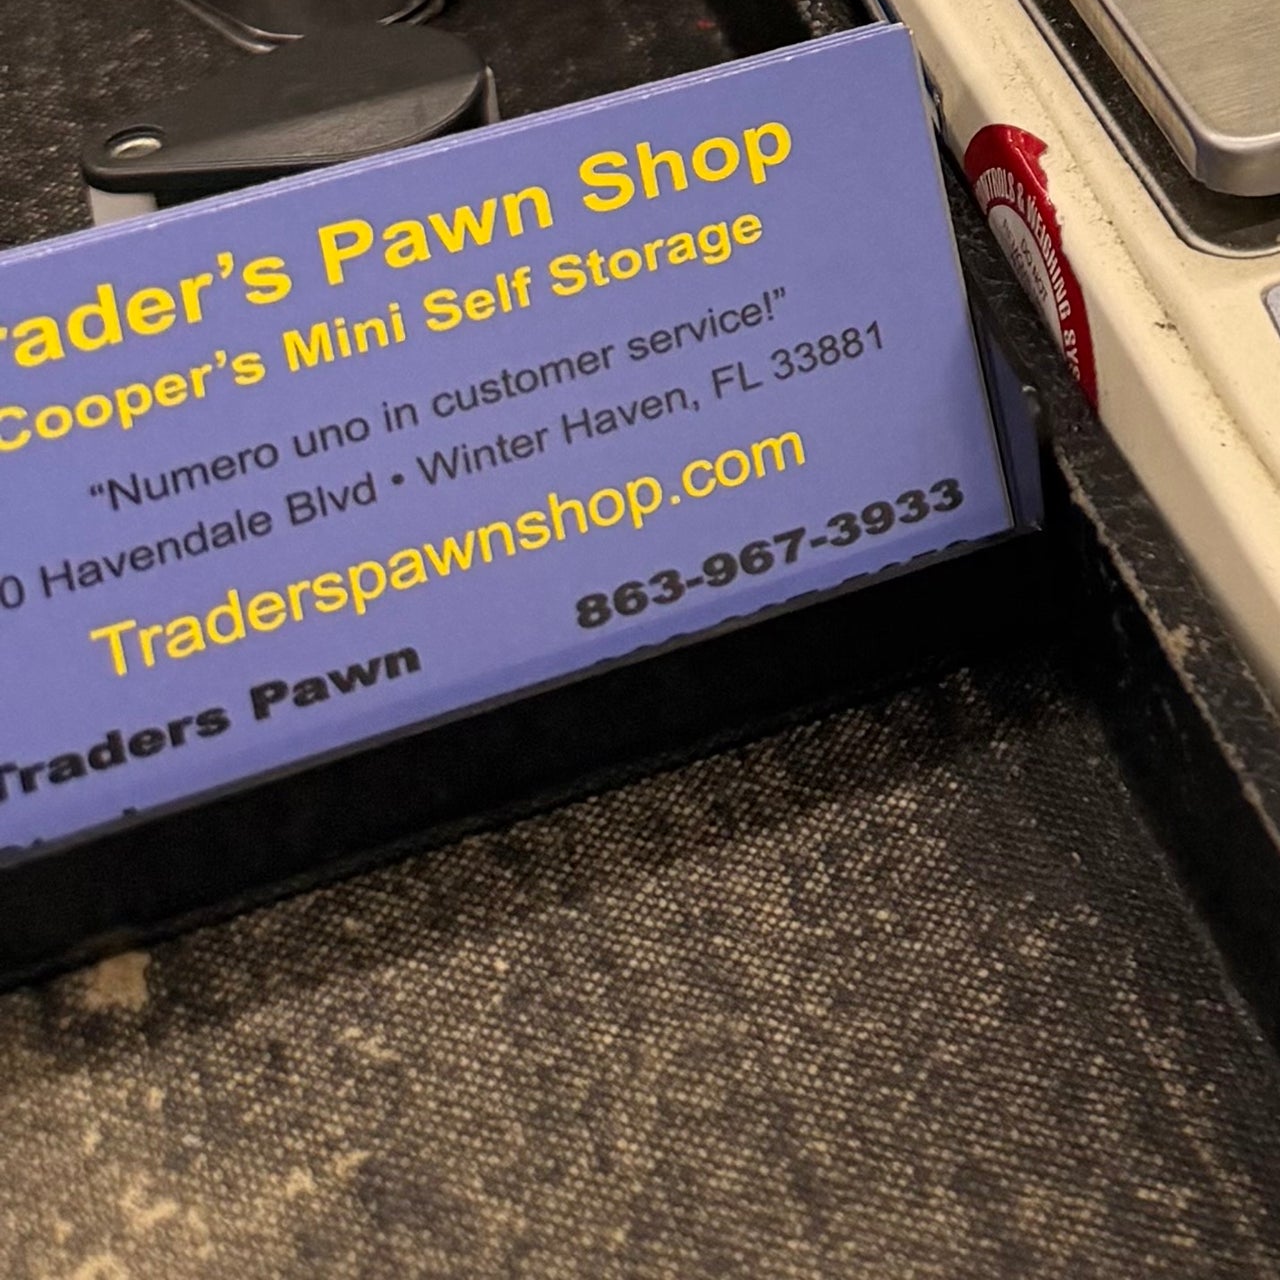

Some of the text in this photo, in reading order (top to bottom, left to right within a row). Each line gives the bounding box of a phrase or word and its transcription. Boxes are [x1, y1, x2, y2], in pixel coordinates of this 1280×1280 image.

[0, 121, 792, 368] ader’s Pawn Shop
[282, 302, 406, 372] Mini
[423, 265, 532, 333] Self
[549, 213, 763, 296] Storage
[40, 509, 272, 598] Havendale
[285, 472, 377, 527] Blvd
[415, 426, 551, 486] Winter
[561, 386, 701, 445] Haven,
[710, 361, 763, 399] FL
[770, 321, 884, 381] 33881
[292, 416, 370, 458] uno
[382, 401, 419, 432] in
[431, 343, 614, 419] customer
[90, 431, 806, 677] Traderspawnshop.com
[576, 478, 964, 629] 863-967-3933
[250, 647, 421, 721] Pawn
